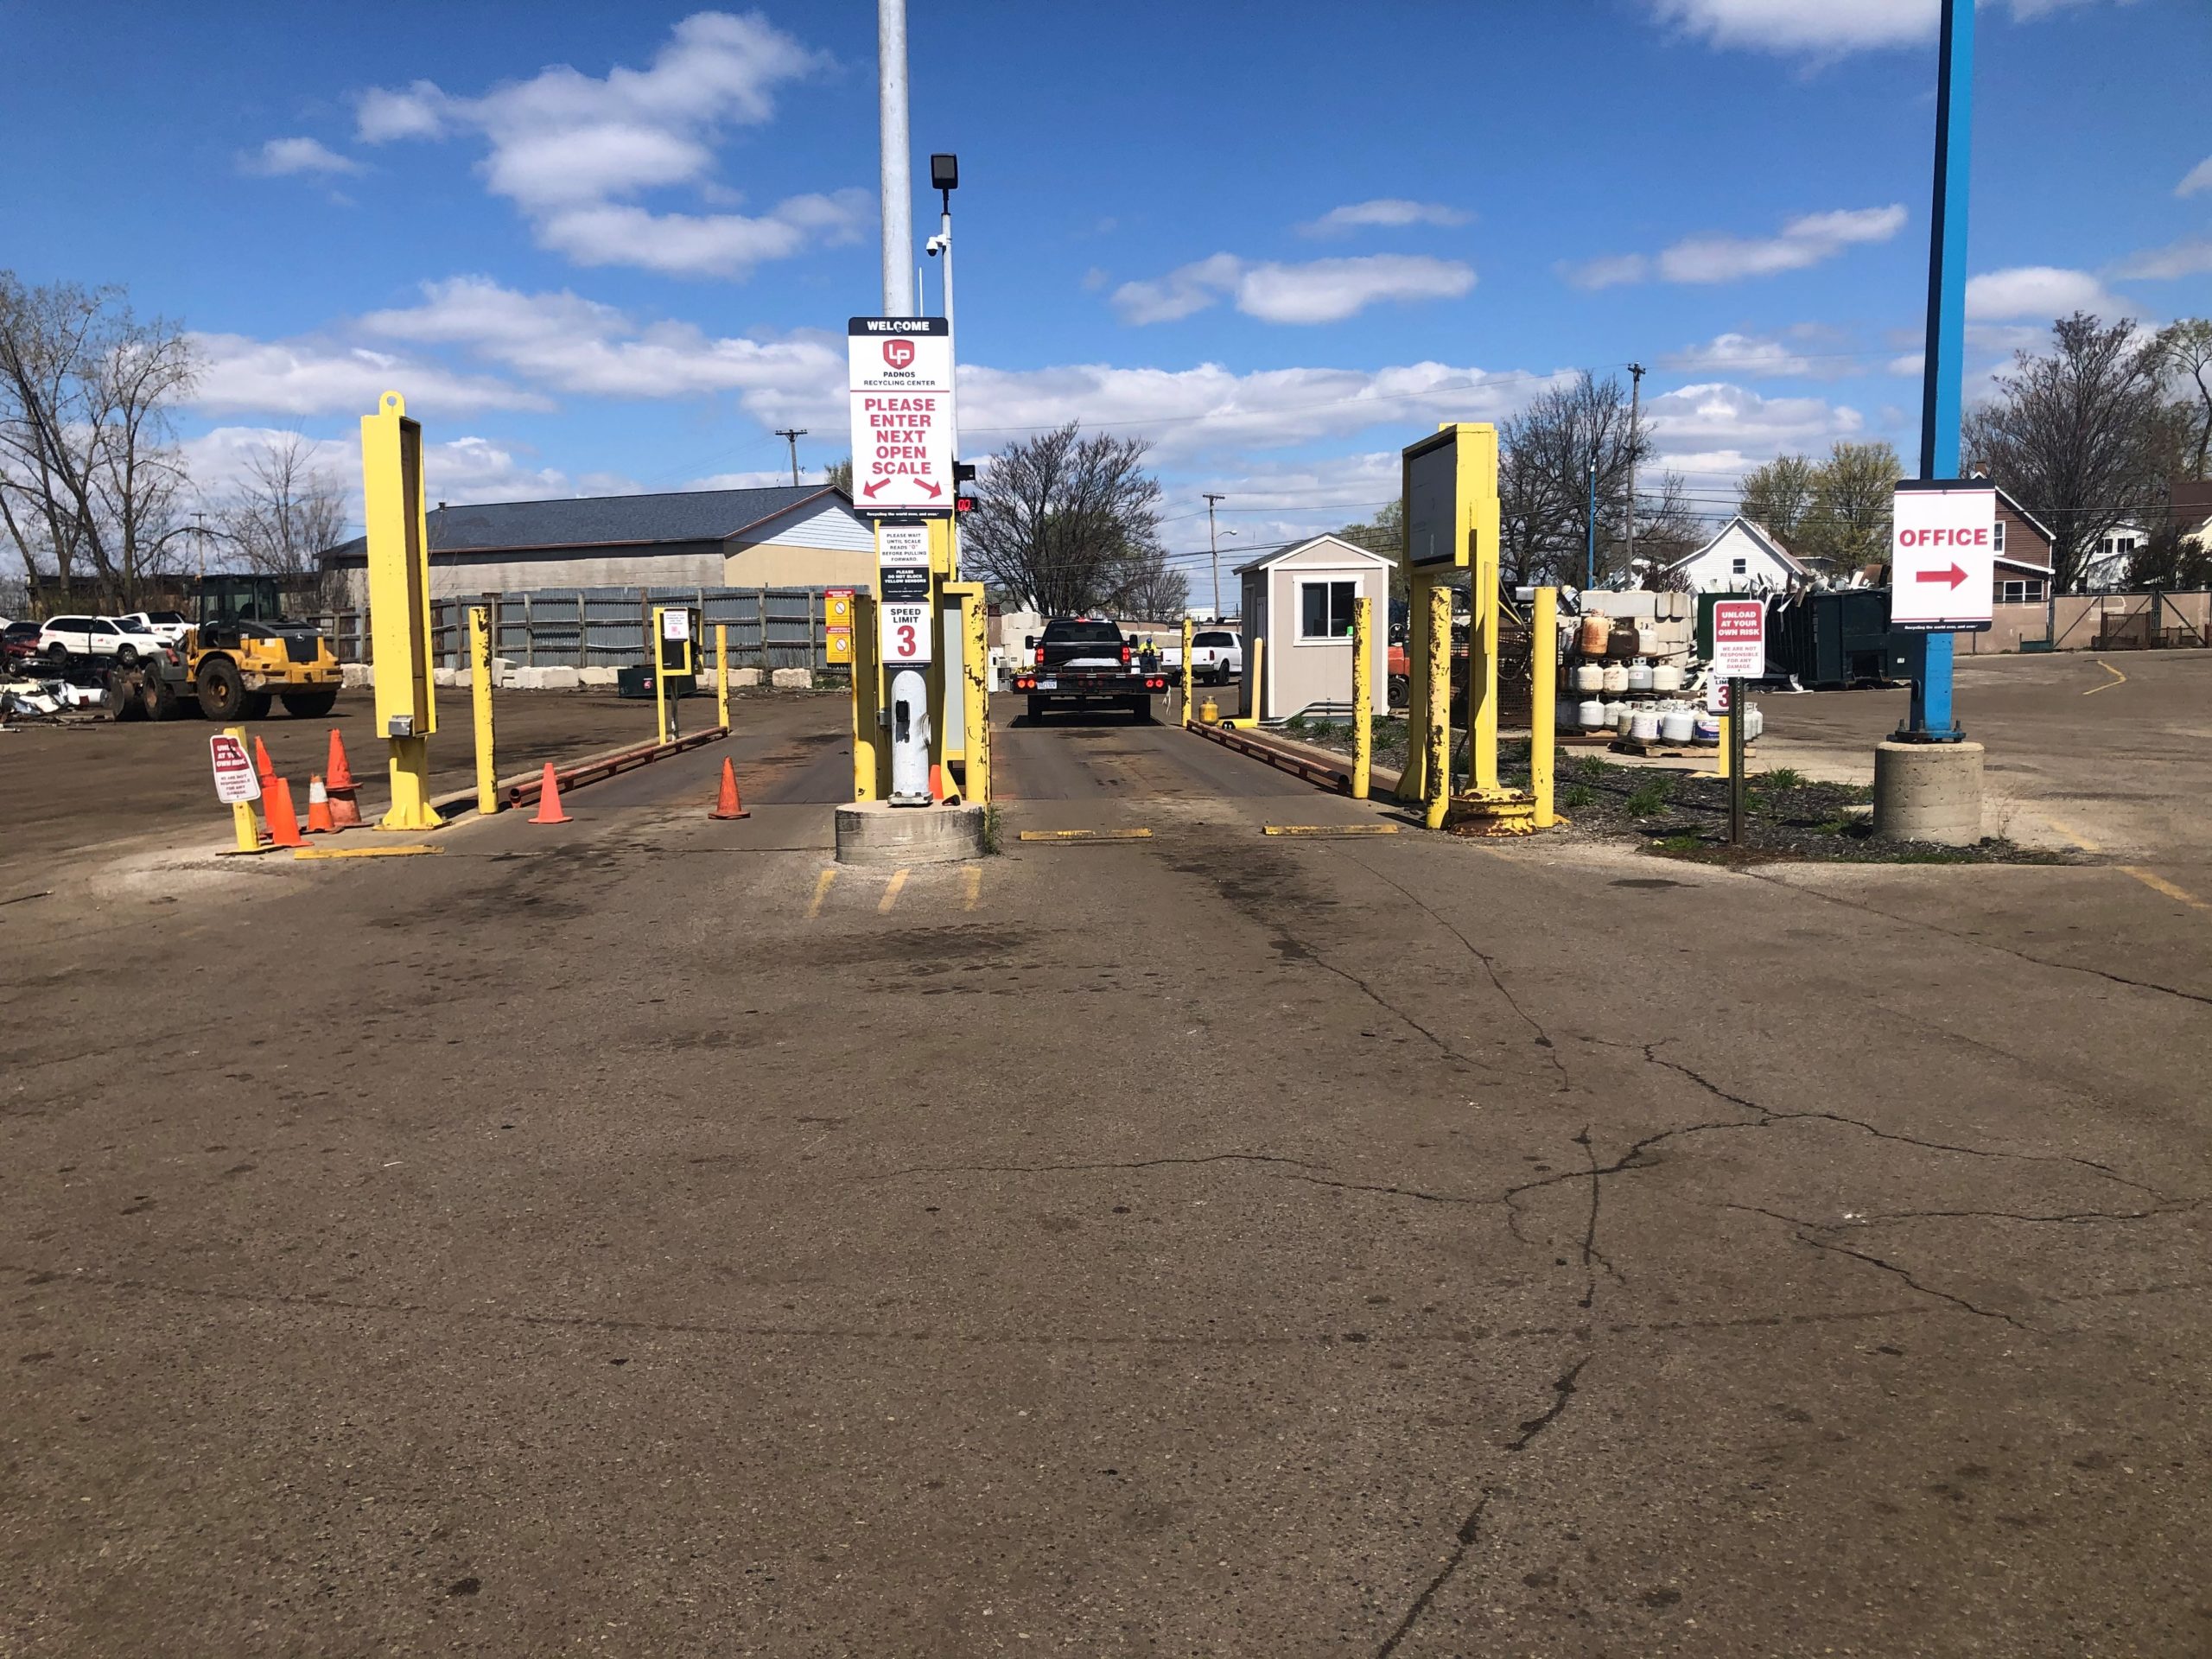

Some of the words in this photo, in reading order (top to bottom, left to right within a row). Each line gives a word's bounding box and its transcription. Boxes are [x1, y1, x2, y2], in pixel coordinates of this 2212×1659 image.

[867, 321, 931, 331] WELCOME
[865, 398, 936, 411] PLEASE
[870, 414, 931, 427] ENTER
[876, 430, 926, 443] NEXT
[876, 446, 926, 459] OPEN
[872, 461, 931, 474] SCALE
[1899, 528, 1988, 547] OFFICE
[897, 625, 917, 657] 3
[1718, 686, 1730, 707] 3
